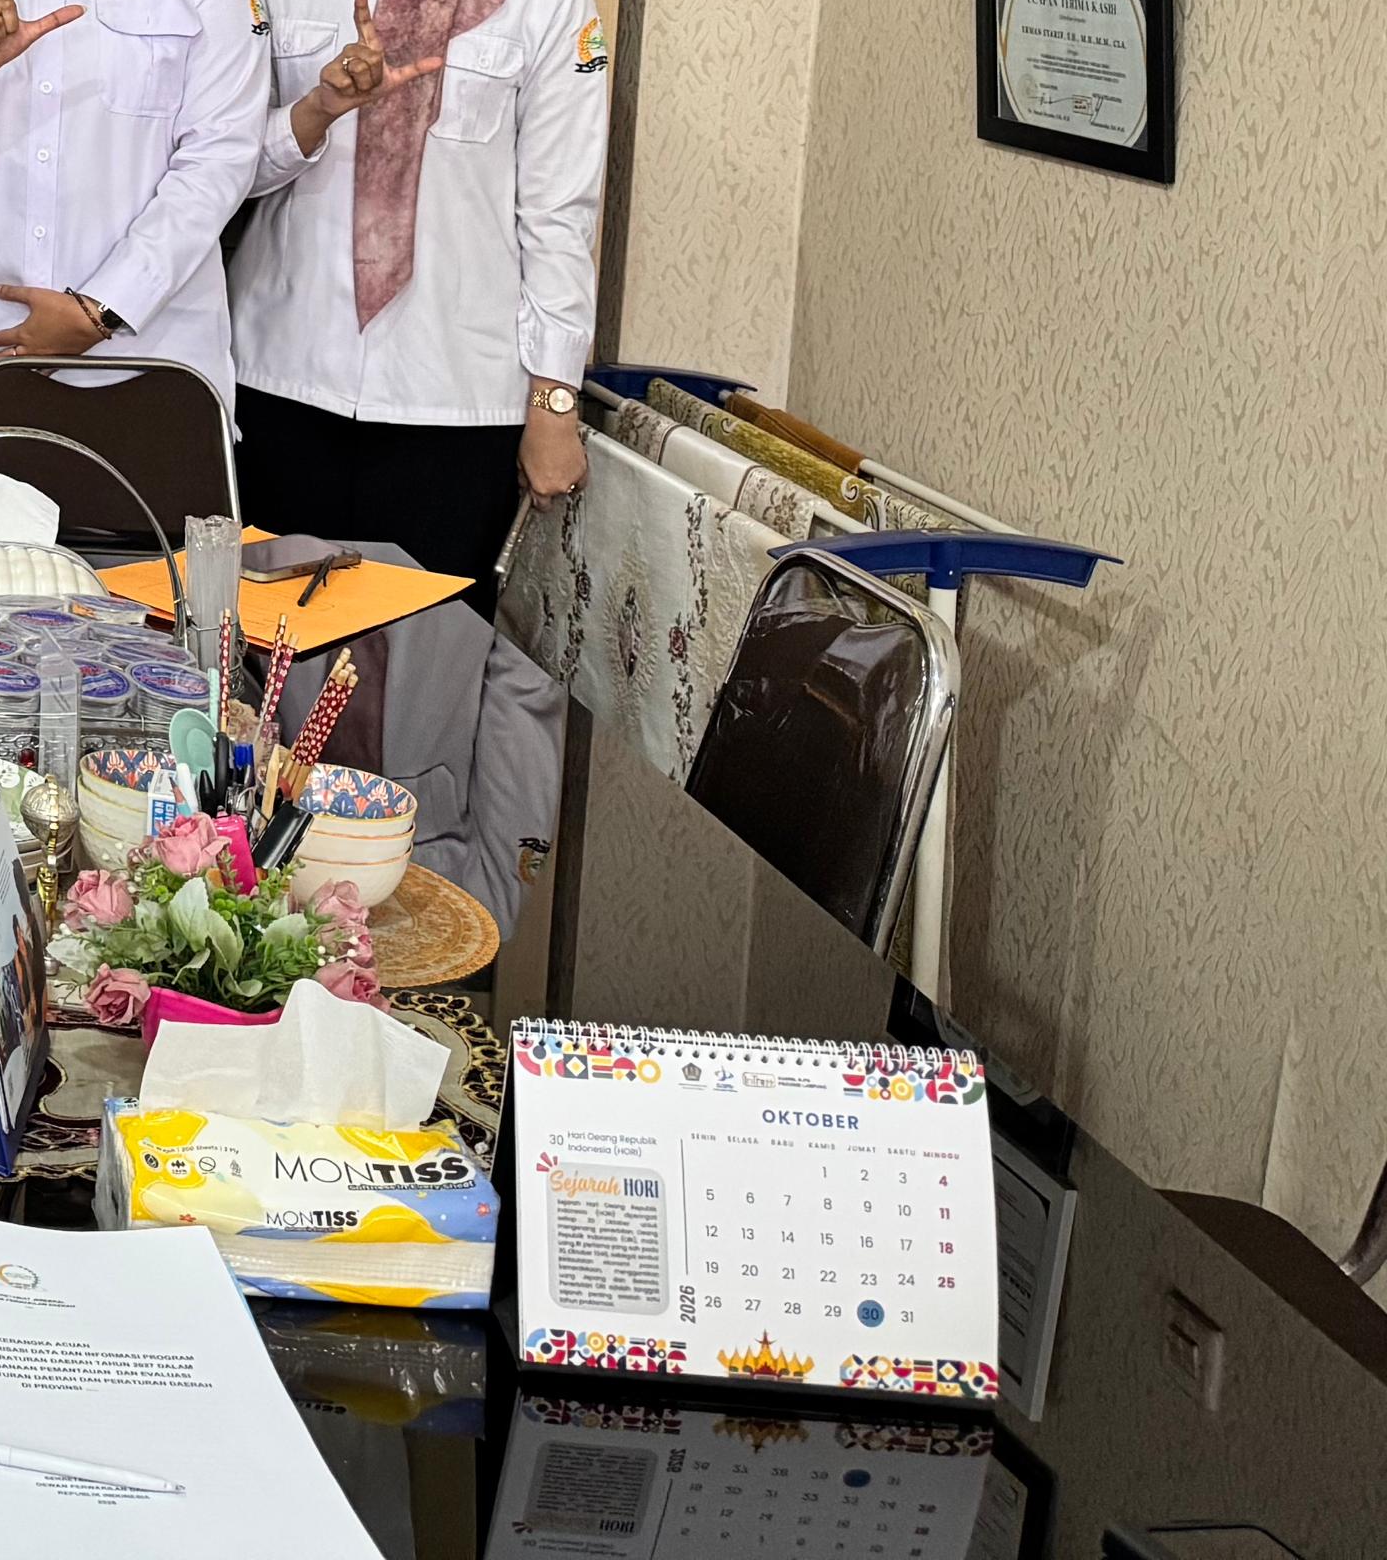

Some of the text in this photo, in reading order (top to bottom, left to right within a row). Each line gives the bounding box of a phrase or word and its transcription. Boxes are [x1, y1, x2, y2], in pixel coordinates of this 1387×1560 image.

[762, 1108, 860, 1131] OKTOBER
[549, 1135, 564, 1145] 30
[568, 1131, 585, 1140] Hari
[568, 1144, 611, 1154] Indonesia
[275, 1151, 469, 1184] MONTISS
[822, 1167, 949, 1187] 1 2 3 4
[550, 1170, 659, 1198] Sejarah HORI
[706, 1188, 950, 1220] 5 6 7 8 9 10 11
[266, 1211, 359, 1227] MONTISS
[705, 1225, 954, 1255] 12 13 14 15 16 17 18
[706, 1262, 956, 1289] 19 20 21 22 23 24 25
[680, 1285, 696, 1324] 2026
[705, 1296, 914, 1324] 26 27 28 29 30 31
